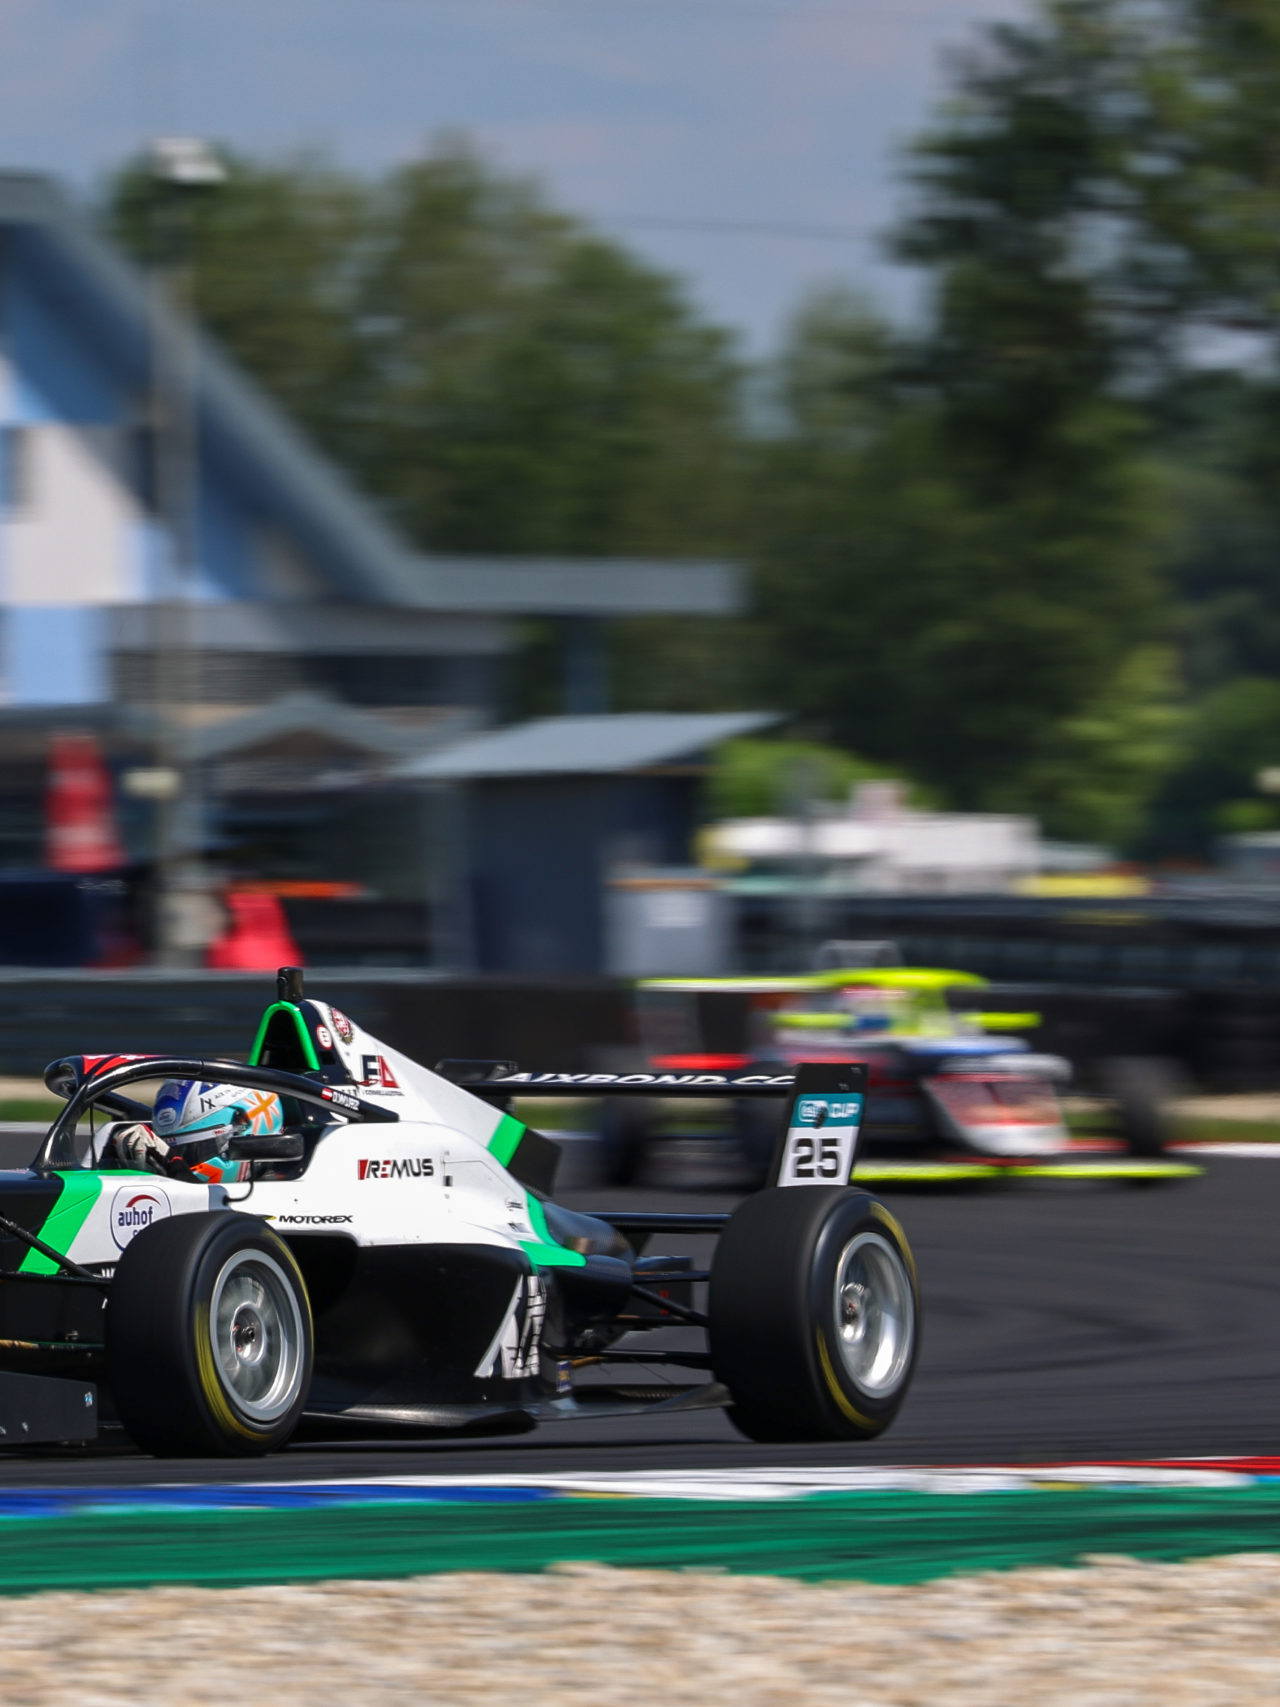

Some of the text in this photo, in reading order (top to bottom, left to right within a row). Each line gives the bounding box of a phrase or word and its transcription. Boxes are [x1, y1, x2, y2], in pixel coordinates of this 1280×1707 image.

[792, 1137, 842, 1179] 25
[365, 1158, 434, 1180] REMUS
[118, 1206, 154, 1227] auhof
[278, 1214, 354, 1225] MOTOREX
